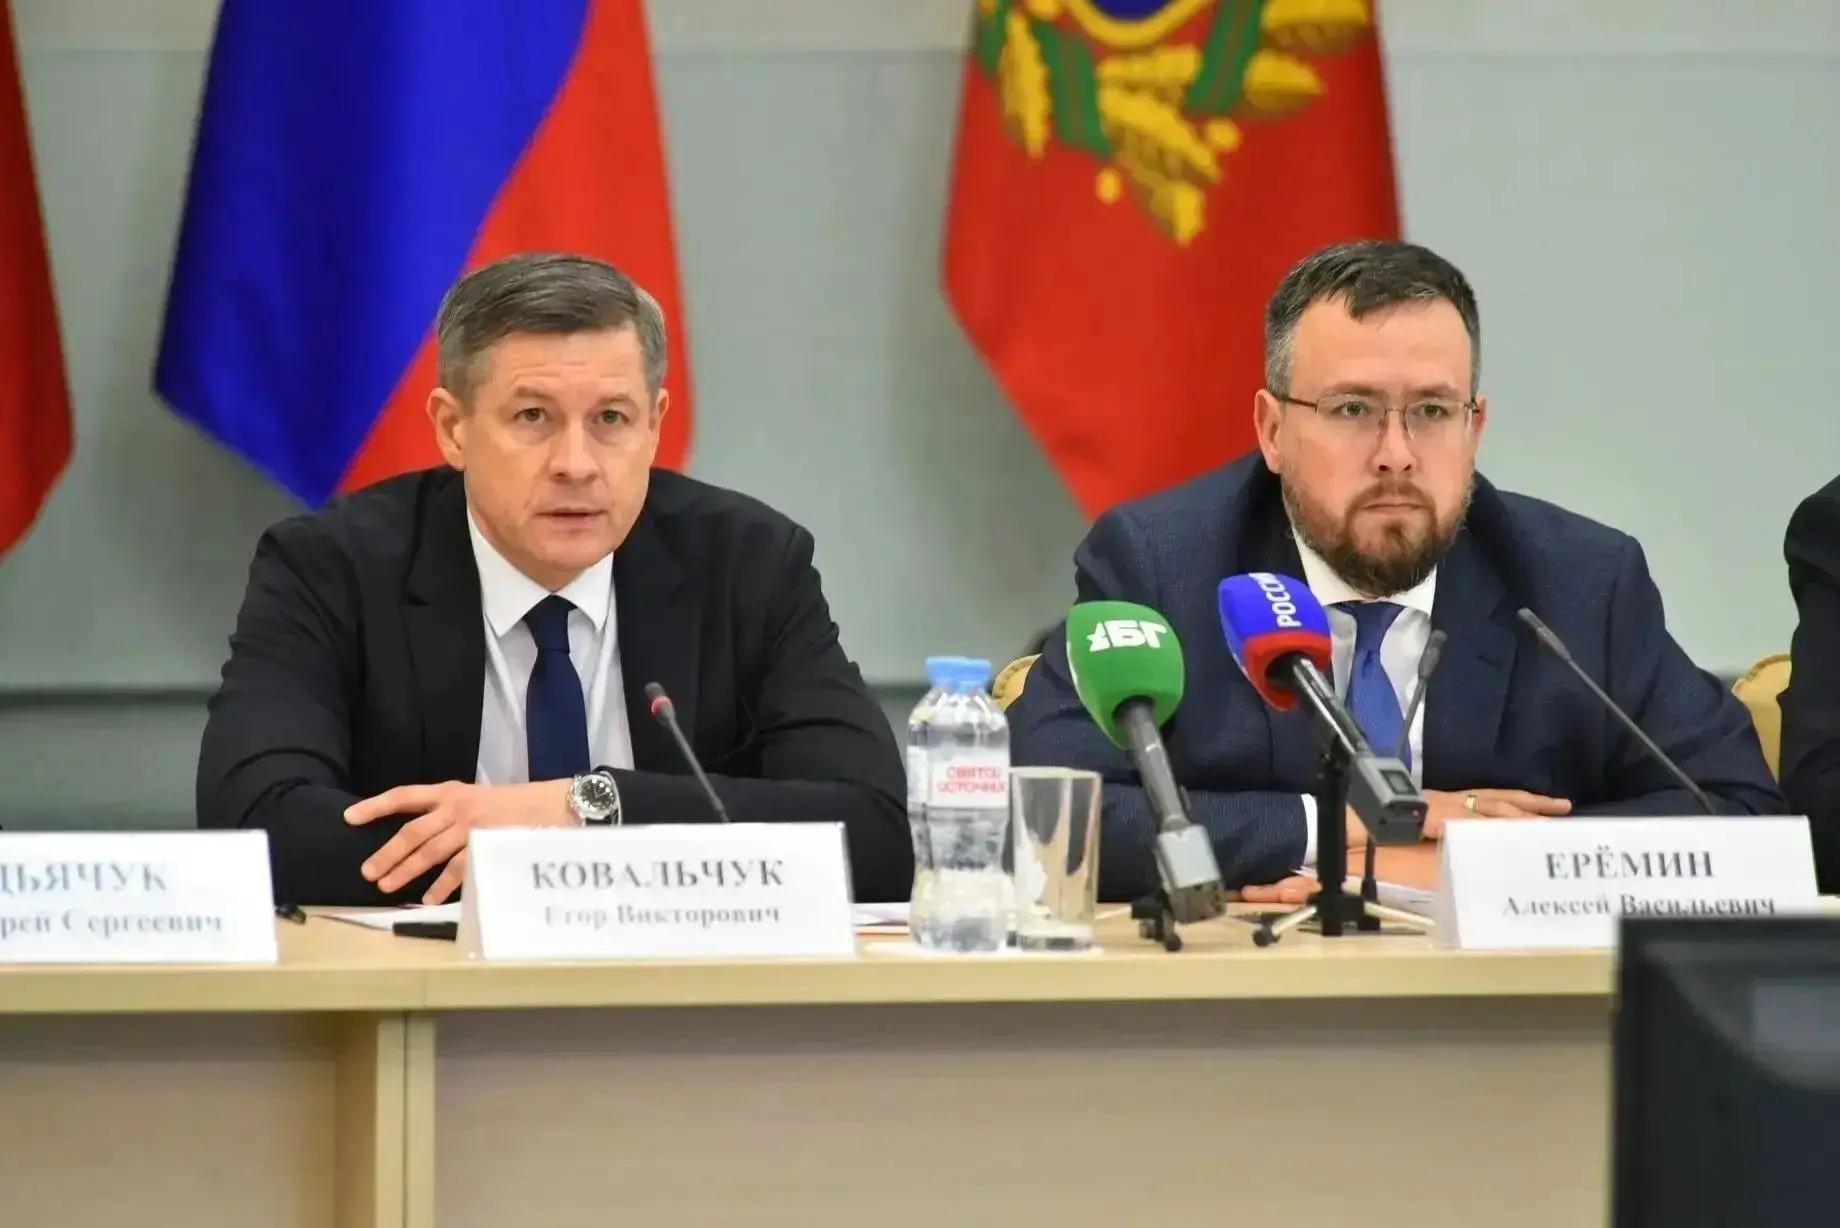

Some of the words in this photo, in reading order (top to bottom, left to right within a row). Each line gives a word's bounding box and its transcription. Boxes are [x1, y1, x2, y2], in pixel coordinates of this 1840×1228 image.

[1247, 572, 1302, 627] РОСС
[531, 859, 784, 890] КОВАЛЬЧУК
[1544, 845, 1715, 880] ЕРЁМИН
[545, 904, 608, 930] Егор
[617, 902, 781, 930] Викторович
[1502, 893, 1611, 916] Алексей
[1619, 893, 1776, 916] Васильевич
[61, 909, 223, 940] Сергеевич
